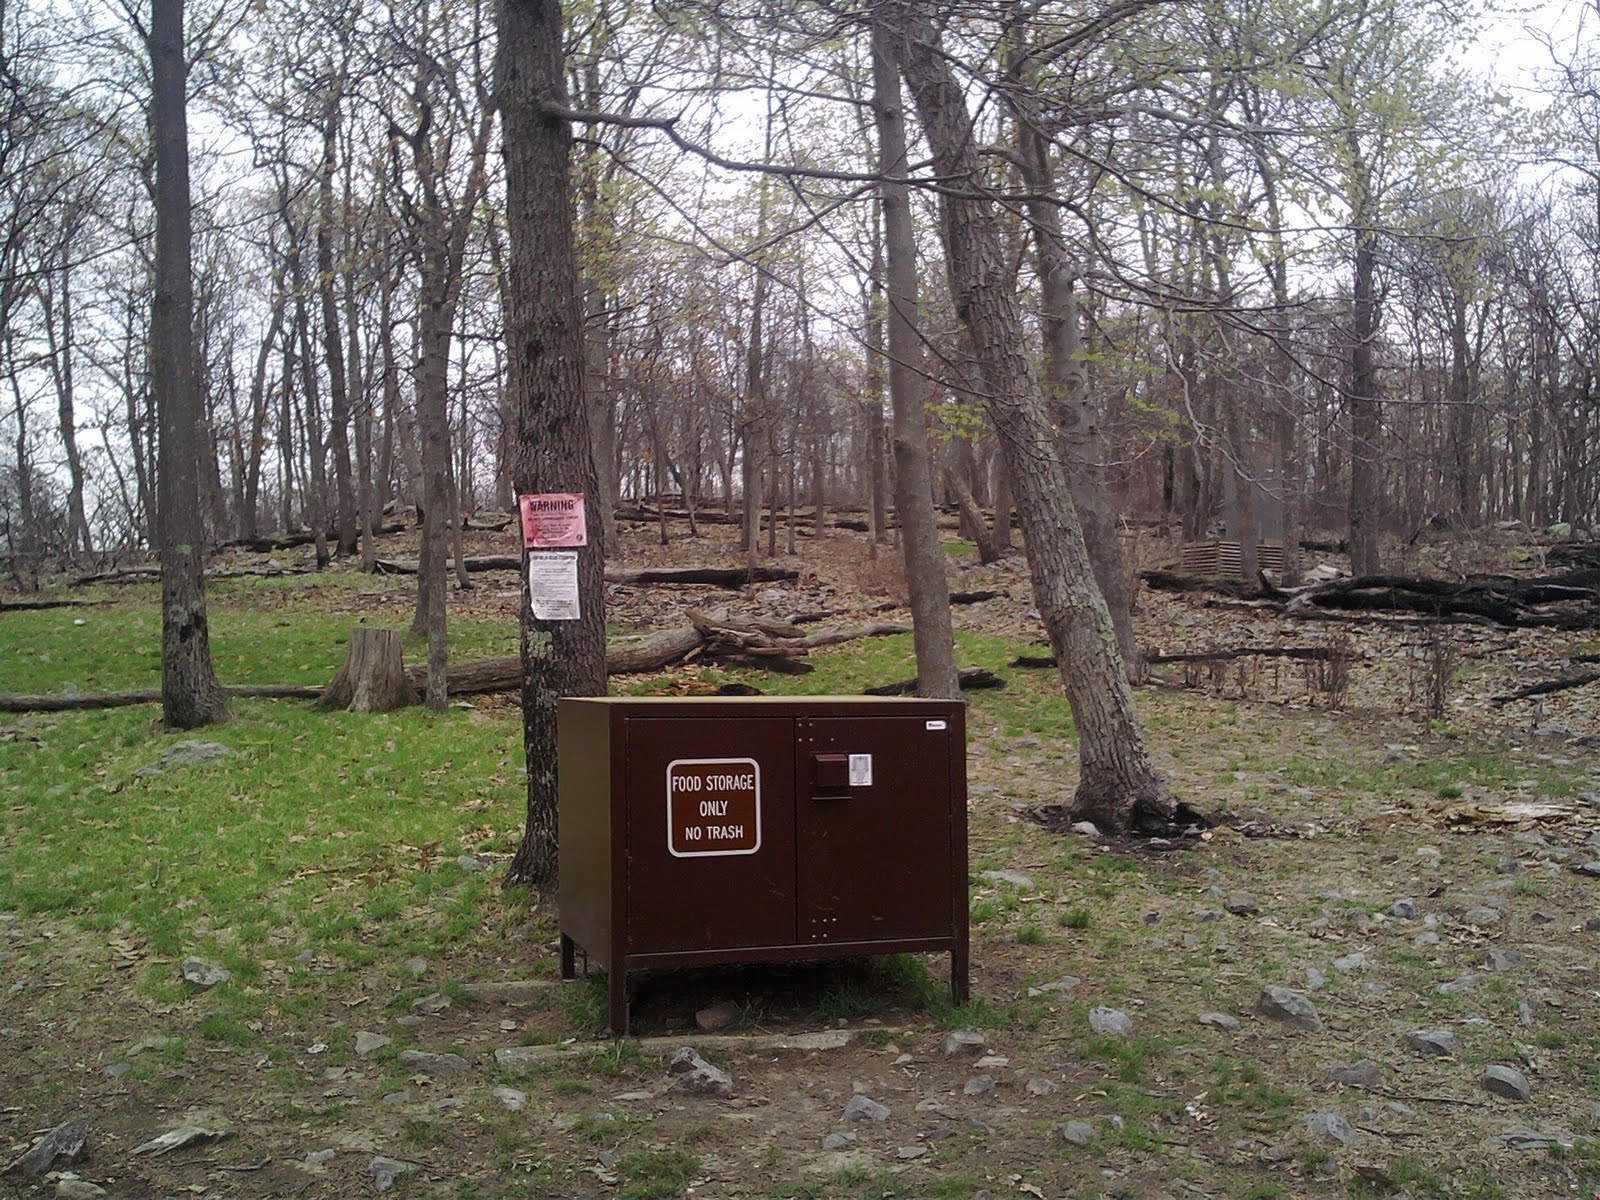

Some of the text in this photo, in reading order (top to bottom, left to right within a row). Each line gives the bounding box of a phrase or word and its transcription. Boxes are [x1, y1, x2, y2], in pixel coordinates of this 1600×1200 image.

[529, 499, 574, 511] WARNING
[672, 774, 754, 792] FOOD STORAGE
[699, 800, 728, 817] ONLY
[685, 825, 743, 840] NO TRASH
